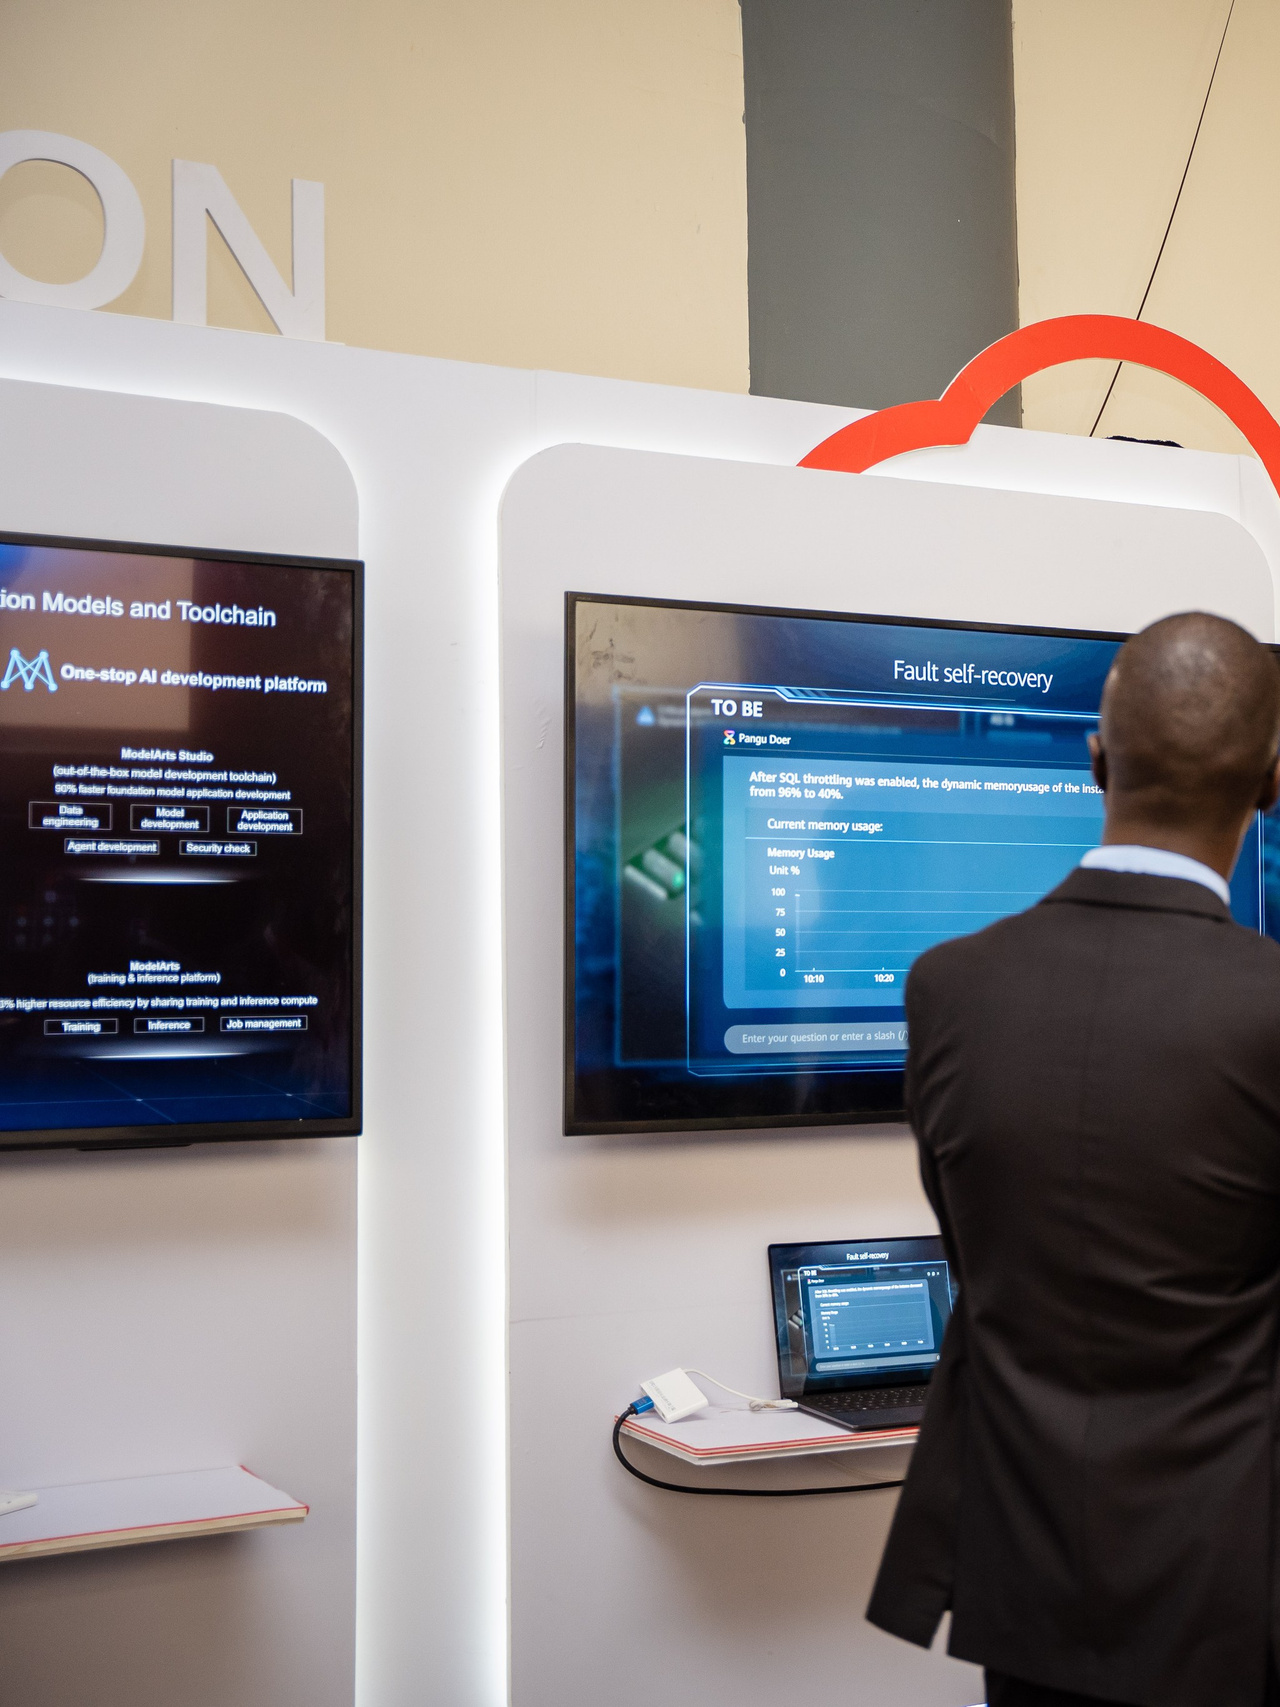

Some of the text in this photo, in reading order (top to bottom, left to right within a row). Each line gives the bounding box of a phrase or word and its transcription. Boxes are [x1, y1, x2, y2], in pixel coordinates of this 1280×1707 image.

[0, 129, 325, 341] ON
[42, 590, 125, 617] Models
[129, 600, 171, 620] and
[176, 601, 277, 627] Toolchain
[60, 663, 328, 694] One-stop AI development platform
[893, 659, 1054, 694] Fault self-recovery
[711, 699, 737, 717] TO
[741, 701, 763, 717] BE
[738, 733, 791, 746] Pangu Doer
[121, 747, 214, 763] ModelArts Studio
[53, 764, 277, 785] (out-of-the-box model development toolchain)
[749, 771, 777, 783] After
[779, 772, 801, 784] SQL
[803, 773, 853, 787] throttling
[855, 777, 875, 786] was
[877, 776, 920, 789] enabled,
[922, 777, 939, 789] the
[941, 778, 982, 792] dynamic
[984, 781, 1050, 795] memoryusage
[1052, 781, 1063, 793] of
[1064, 782, 1080, 793] the
[78, 783, 106, 795] faster
[107, 784, 156, 797] foundation
[156, 786, 185, 798] model
[186, 787, 234, 800] application
[235, 789, 291, 802] development
[749, 786, 844, 799] from 96% to 40%.
[59, 804, 84, 816] Data
[156, 806, 185, 818] Model
[241, 809, 289, 822] Application
[42, 816, 100, 830] engineering
[140, 818, 199, 831] development
[237, 821, 293, 834] development
[767, 818, 883, 835] Current memory usage:
[67, 841, 157, 854] Agent development
[186, 842, 251, 855] Security check
[767, 847, 835, 860] Memory Usage
[769, 865, 800, 875] Unit %
[771, 887, 786, 897] 100
[775, 908, 786, 917] 75
[775, 928, 786, 937] 50
[775, 948, 786, 957] 25
[129, 960, 180, 972] ModelArts
[779, 968, 786, 977] 0
[88, 972, 221, 986] (training & inference platform)
[803, 974, 825, 983] 10:10
[874, 973, 895, 983] 10:20
[16, 998, 47, 1012] higher
[48, 999, 91, 1010] resource
[92, 997, 136, 1011] efficiency
[137, 997, 149, 1010] by
[150, 997, 184, 1009] sharing
[186, 996, 219, 1009] training
[220, 996, 238, 1007] and
[239, 996, 279, 1006] inference
[281, 995, 318, 1007] compute
[62, 1022, 101, 1034] Training
[148, 1020, 191, 1032] Inference
[226, 1018, 302, 1031] Job management
[742, 1033, 765, 1044] Enter
[768, 1034, 788, 1045] your
[790, 1032, 828, 1045] question
[830, 1033, 839, 1042] or
[841, 1031, 864, 1042] enter
[866, 1032, 872, 1041] a
[874, 1030, 895, 1041] slash
